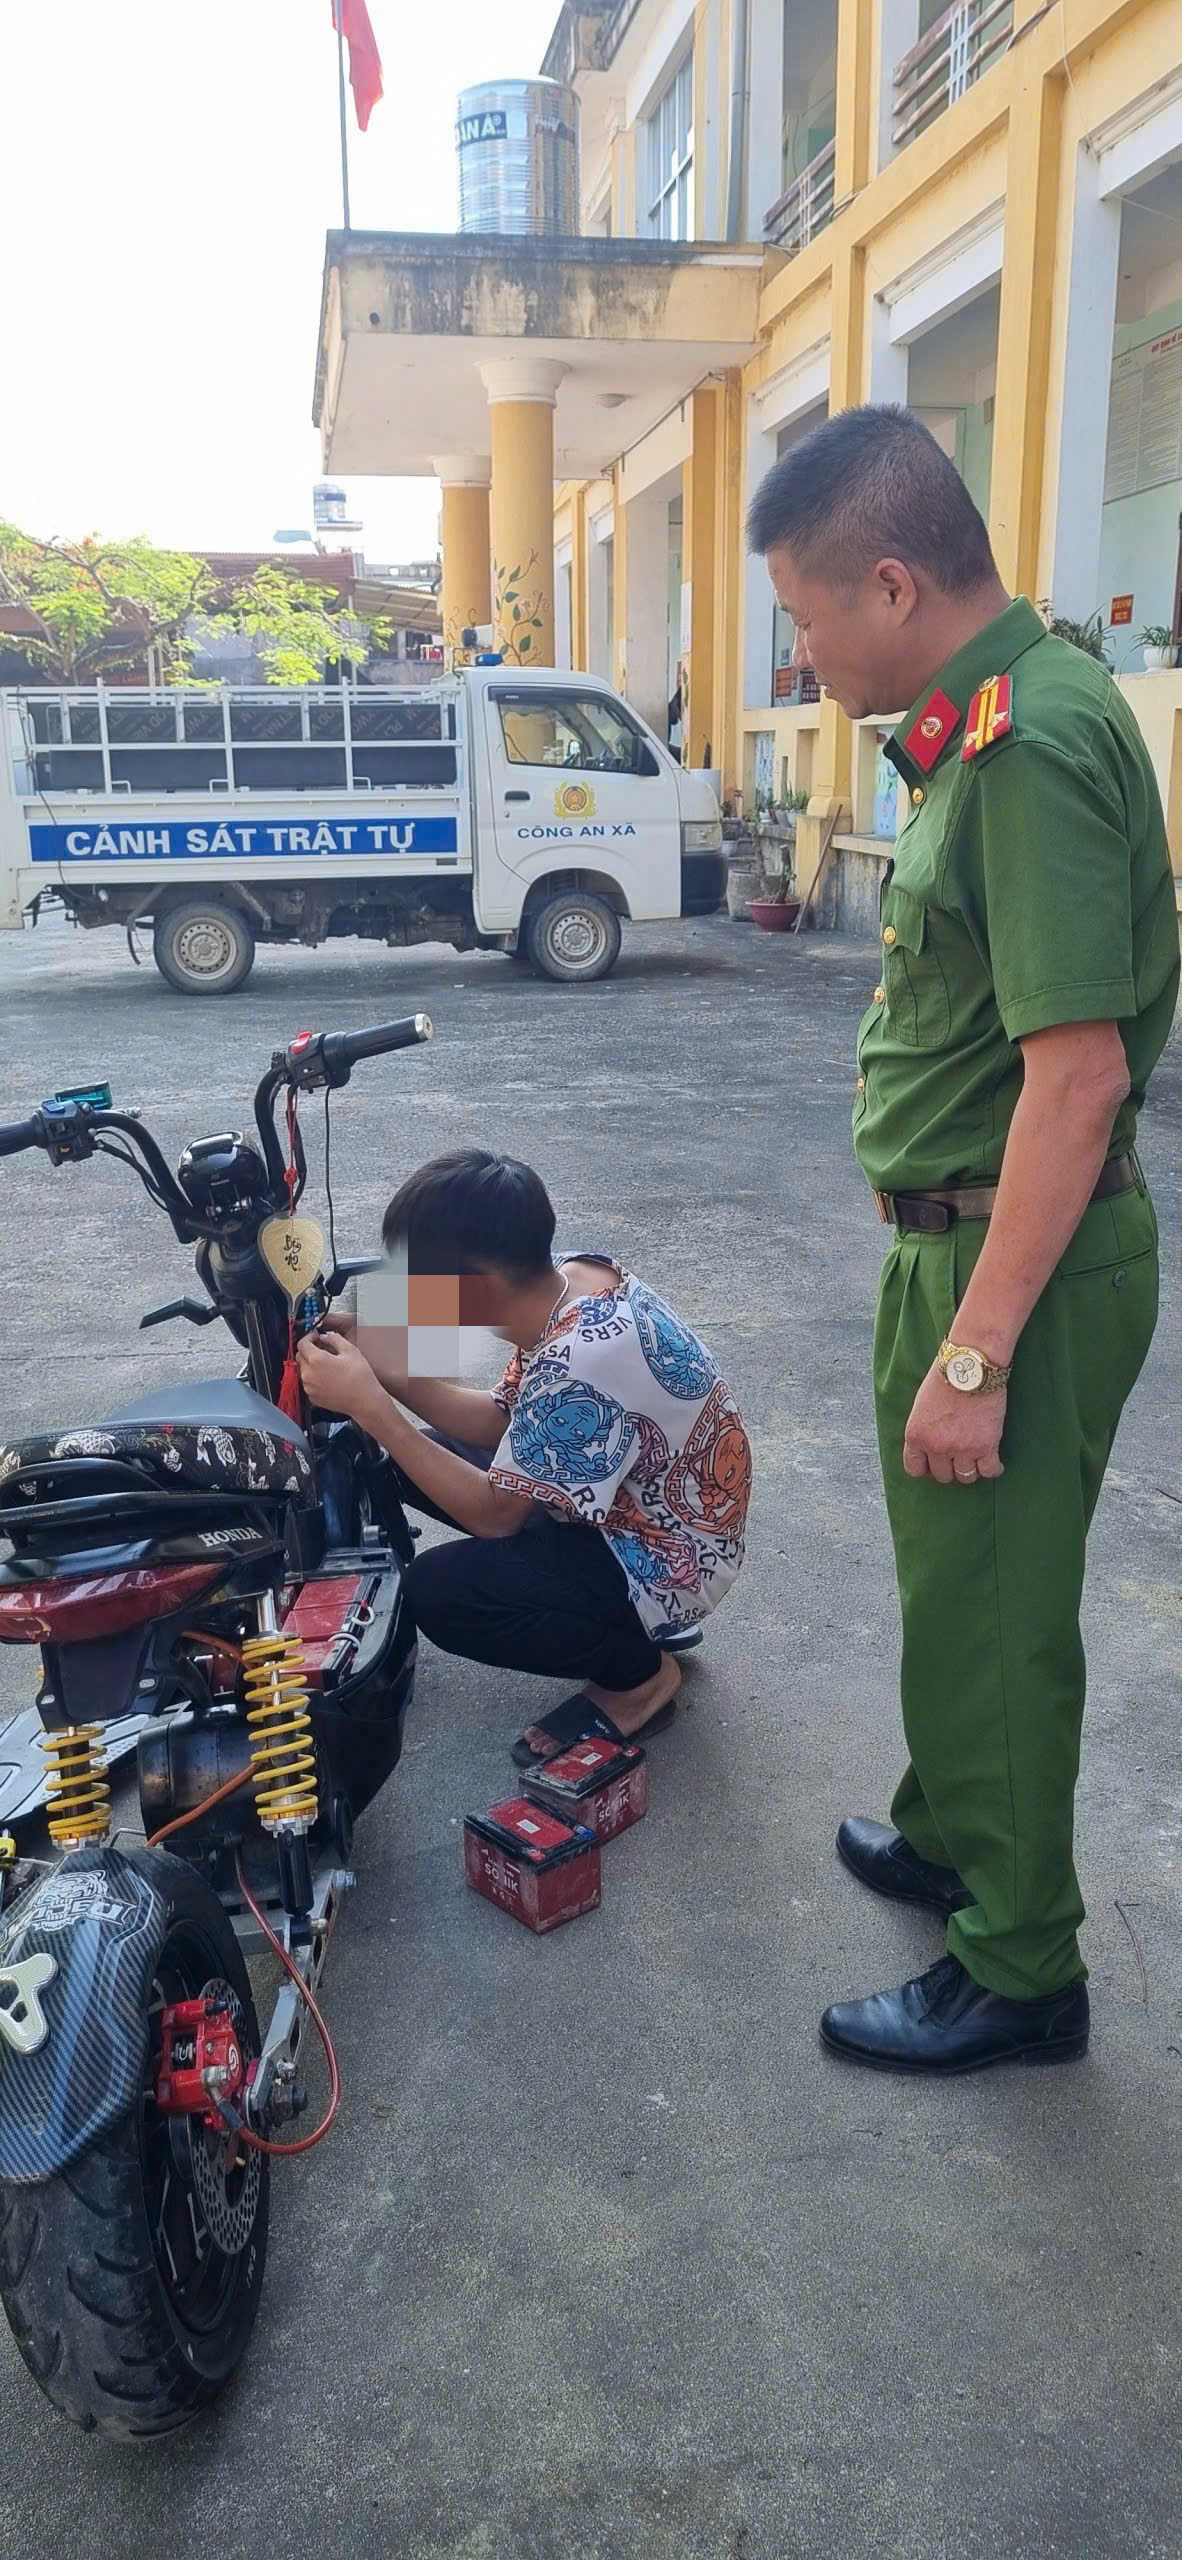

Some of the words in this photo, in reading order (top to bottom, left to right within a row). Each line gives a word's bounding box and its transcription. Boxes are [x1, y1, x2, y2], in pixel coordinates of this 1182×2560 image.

[66, 824, 170, 856] CẢNH
[186, 823, 256, 853] SÁT
[267, 822, 358, 855] TRẬT
[367, 822, 415, 853] TỰ
[517, 825, 573, 839] CÔNG
[580, 825, 605, 838] AN
[611, 822, 636, 836] XÃ
[577, 1316, 632, 1343] VERS
[197, 1527, 263, 1547] HONDA
